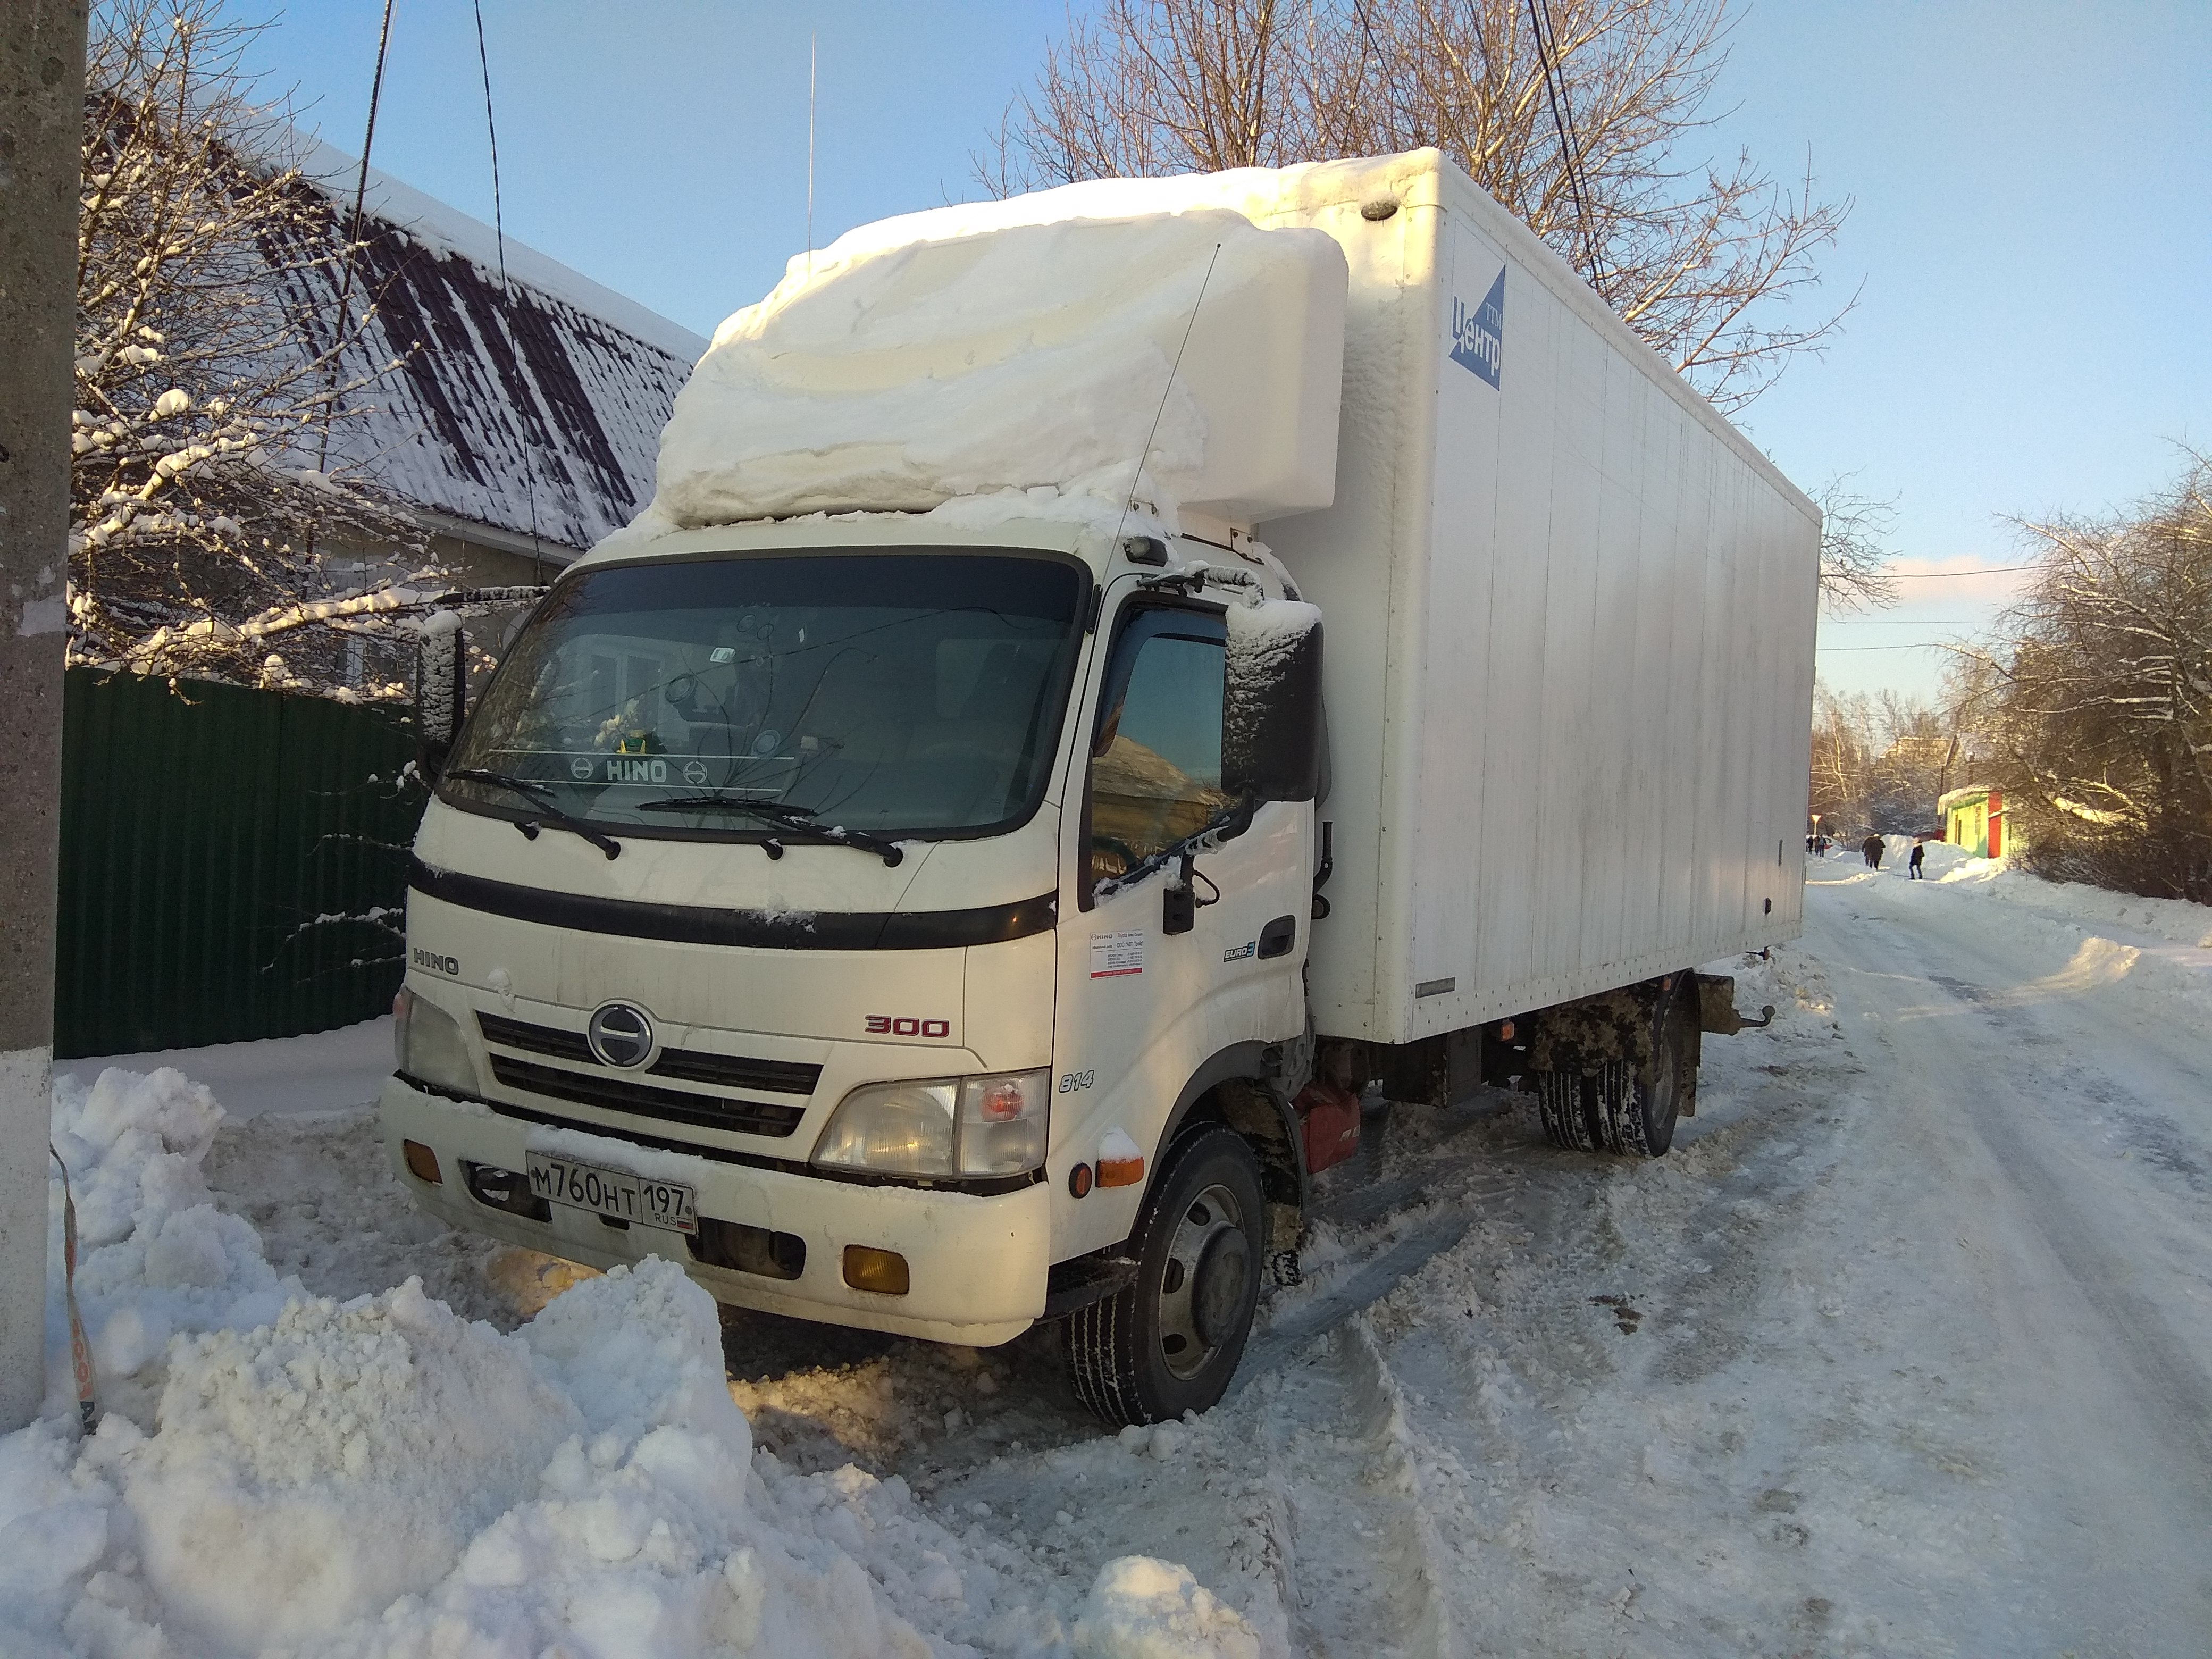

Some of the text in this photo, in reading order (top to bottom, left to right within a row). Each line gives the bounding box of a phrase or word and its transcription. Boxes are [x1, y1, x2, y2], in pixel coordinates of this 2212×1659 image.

[1452, 296, 1501, 377] Центр
[607, 760, 667, 783] HINO
[413, 947, 459, 975] HINO
[865, 1015, 950, 1038] 300
[1059, 1070, 1094, 1093] 814
[643, 1185, 684, 1216] 197
[655, 1213, 676, 1226] RUS
